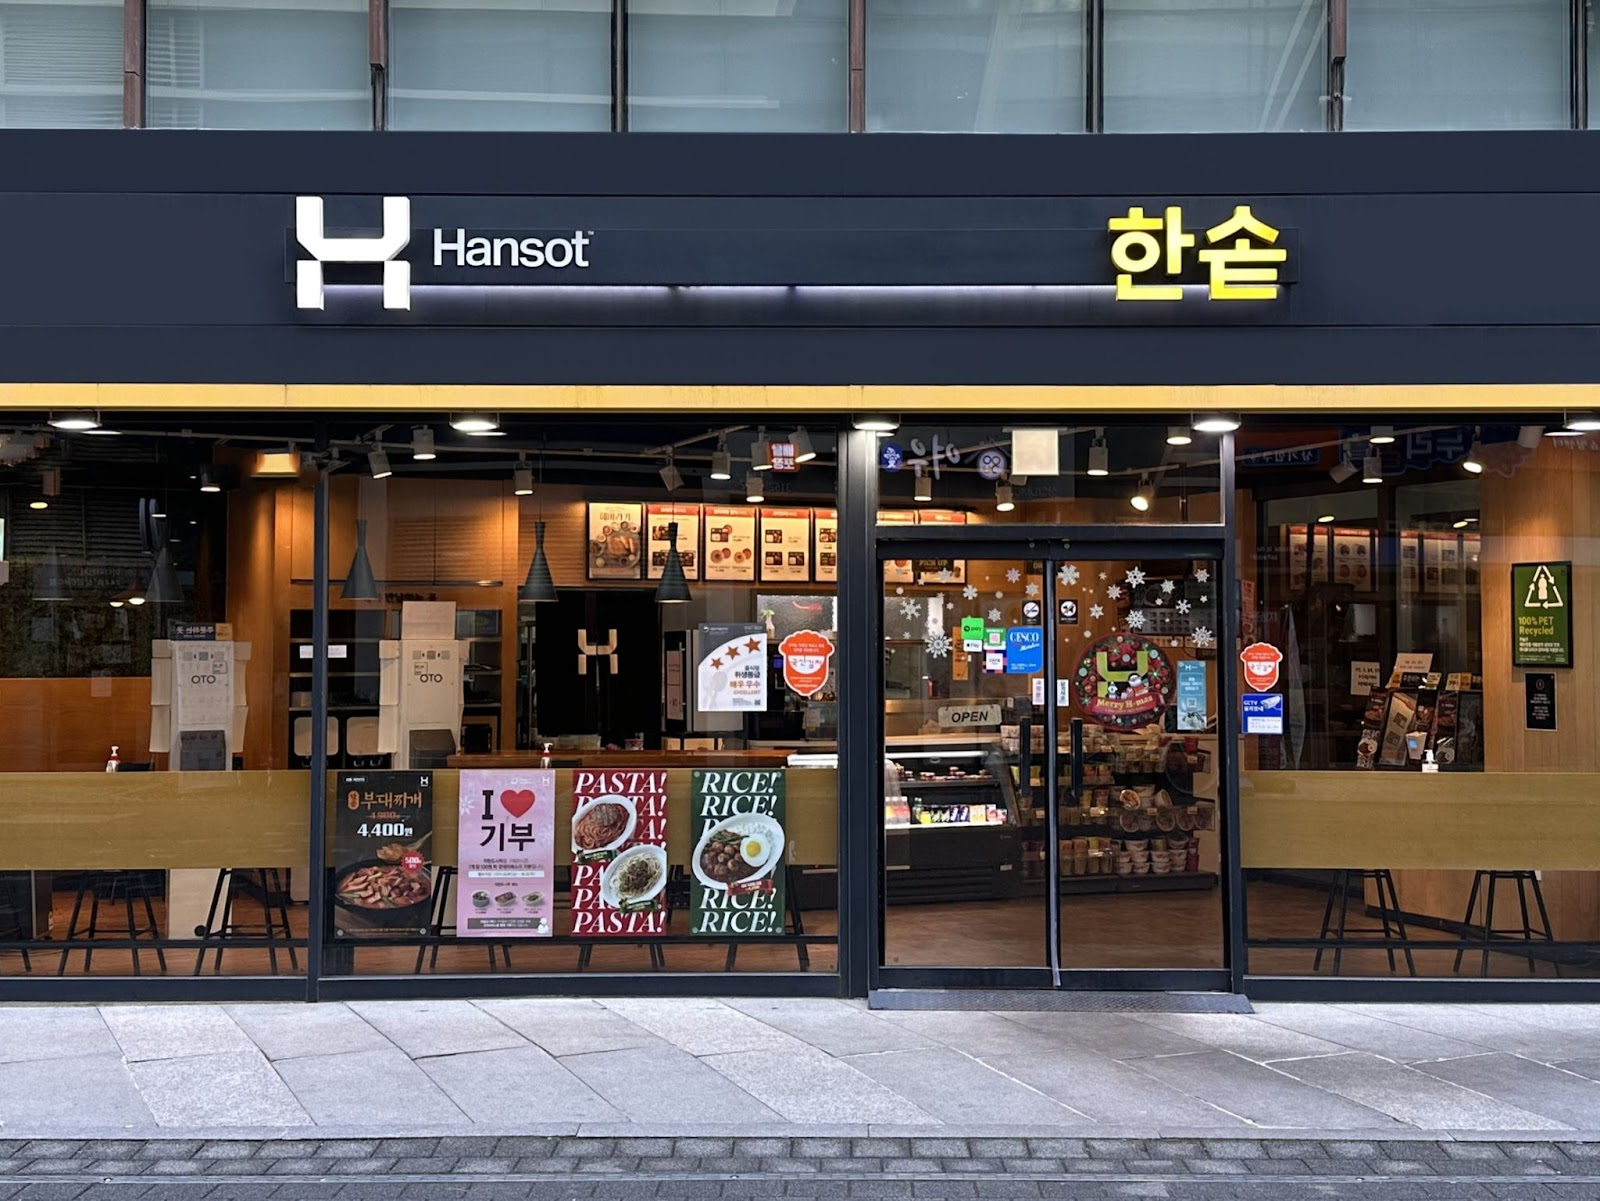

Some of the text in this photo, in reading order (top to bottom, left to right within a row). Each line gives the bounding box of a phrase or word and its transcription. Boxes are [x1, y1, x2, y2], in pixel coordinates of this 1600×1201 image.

[433, 228, 590, 267] Hansot
[1108, 205, 1287, 300] 한솥
[1518, 616, 1554, 626] 100% PET
[1519, 625, 1554, 637] Recycled
[1009, 631, 1039, 643] CESCO
[191, 674, 216, 684] OTO
[419, 673, 443, 683] OTO
[1096, 698, 1125, 710] Merry
[951, 711, 989, 723] OPEN
[574, 772, 667, 794] PASTA!
[700, 772, 778, 794] RICE!
[360, 791, 422, 811] 부대찌개
[481, 789, 494, 820] I
[700, 795, 777, 817] RICE!
[480, 823, 535, 852] 기부
[571, 911, 666, 934] PASTA!
[700, 911, 777, 934] RICE!
